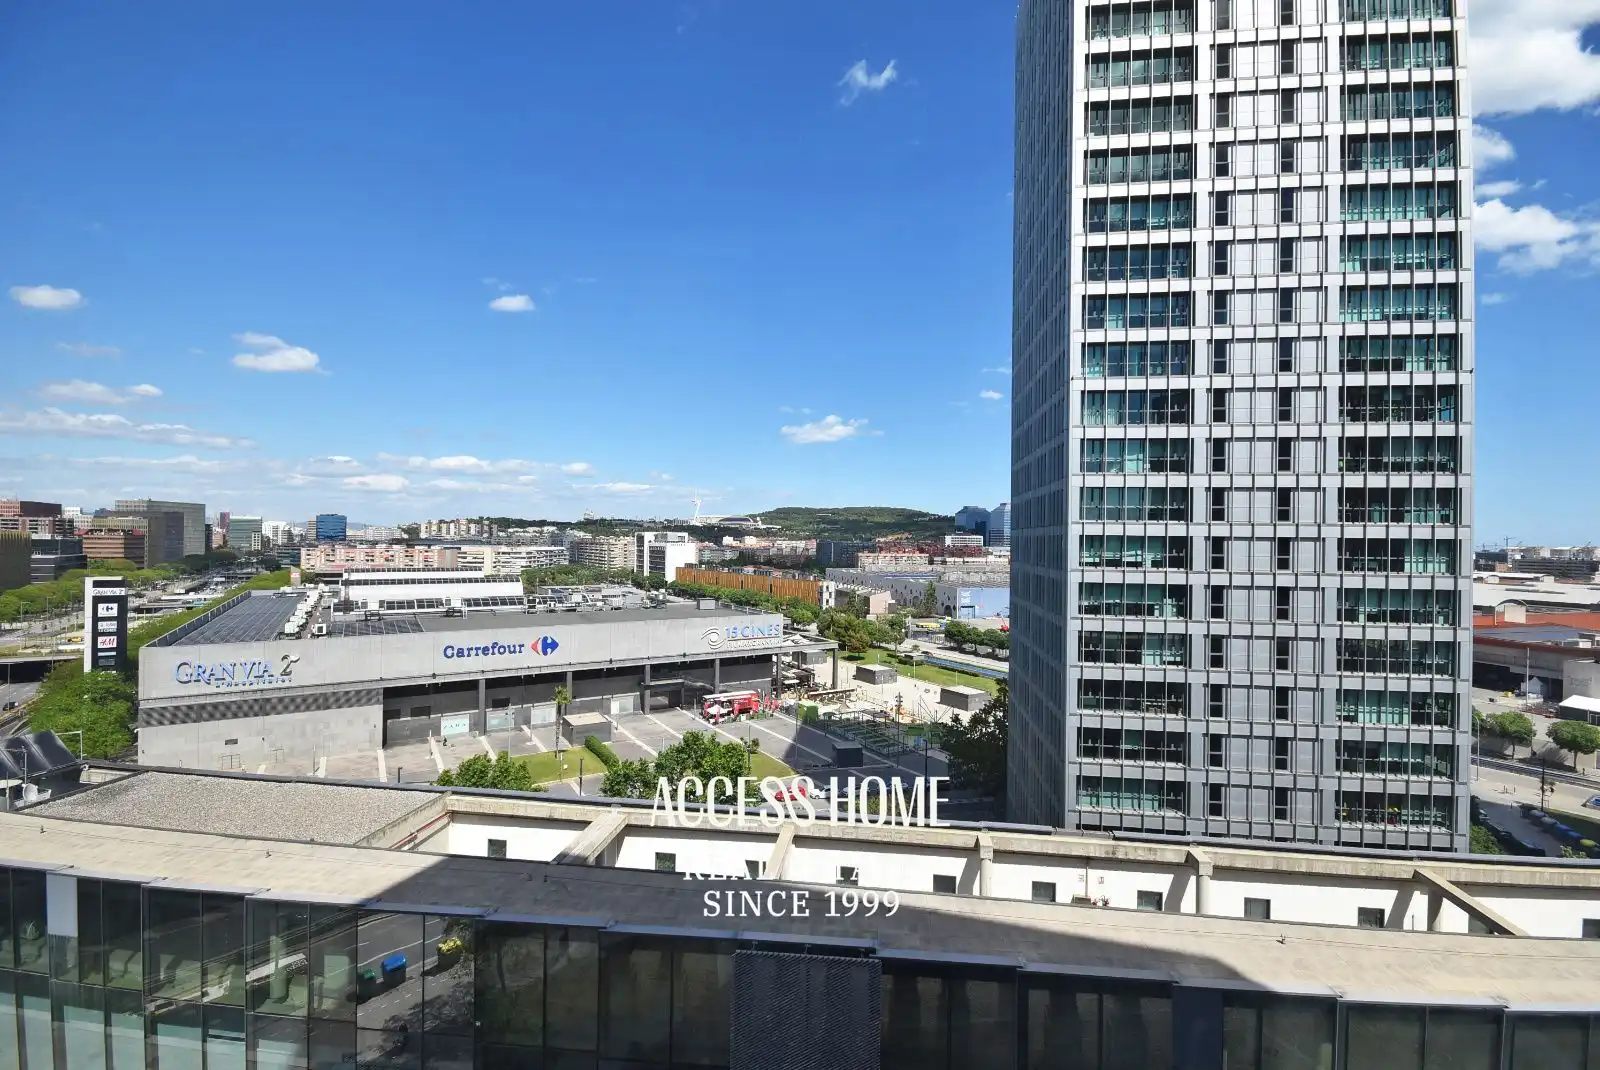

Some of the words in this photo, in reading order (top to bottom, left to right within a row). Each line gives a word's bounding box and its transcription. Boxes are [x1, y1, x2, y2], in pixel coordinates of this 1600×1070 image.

[726, 627, 738, 638] 15
[741, 624, 781, 637] CINES
[443, 641, 525, 659] Carrefour
[175, 661, 237, 685] GRAN
[239, 660, 274, 679] VIA
[280, 654, 300, 676] 2
